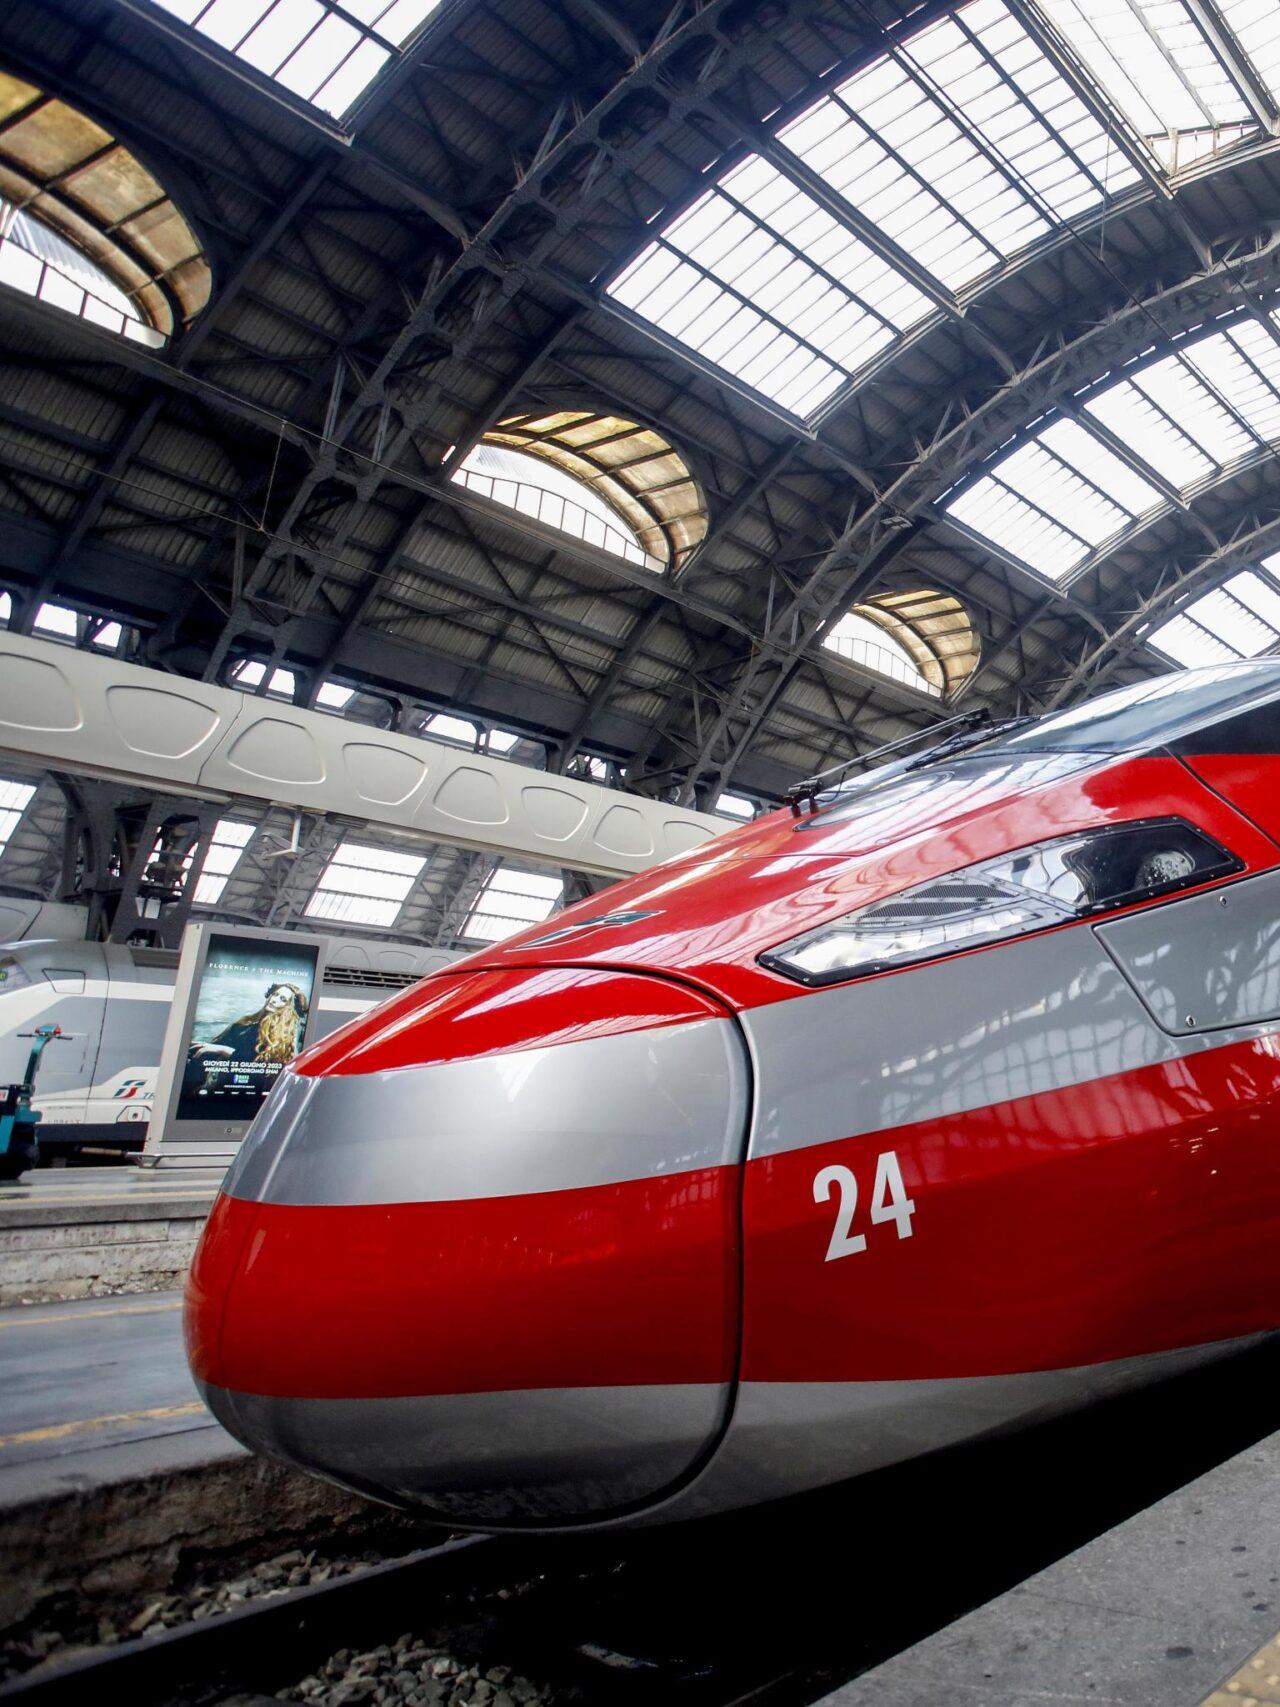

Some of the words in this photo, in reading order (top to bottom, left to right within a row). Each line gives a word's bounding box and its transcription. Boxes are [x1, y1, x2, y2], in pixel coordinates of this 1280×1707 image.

[209, 962, 249, 971] FLORENCE
[276, 968, 309, 977] MACHINE
[812, 1150, 916, 1262] 24
